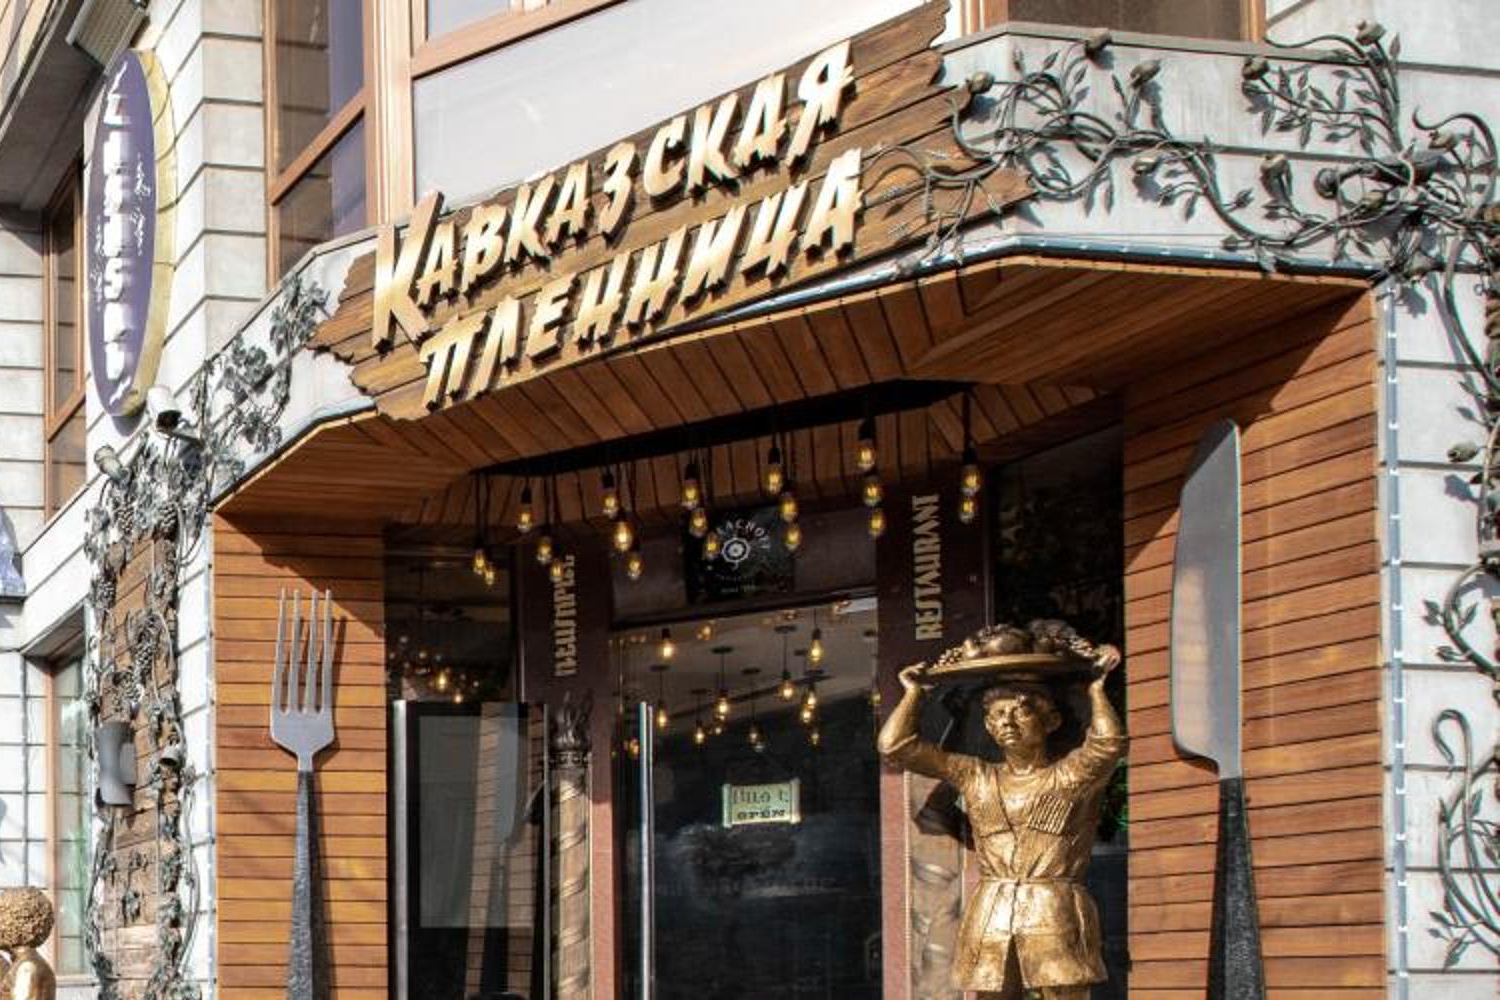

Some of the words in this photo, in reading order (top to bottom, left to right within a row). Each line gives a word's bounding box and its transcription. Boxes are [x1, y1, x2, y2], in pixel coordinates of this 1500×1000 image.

[372, 39, 855, 351] КАВКАЗСКАЯ
[420, 146, 865, 411] ПЛЕННИЦА
[911, 494, 943, 640] RESTAURANT
